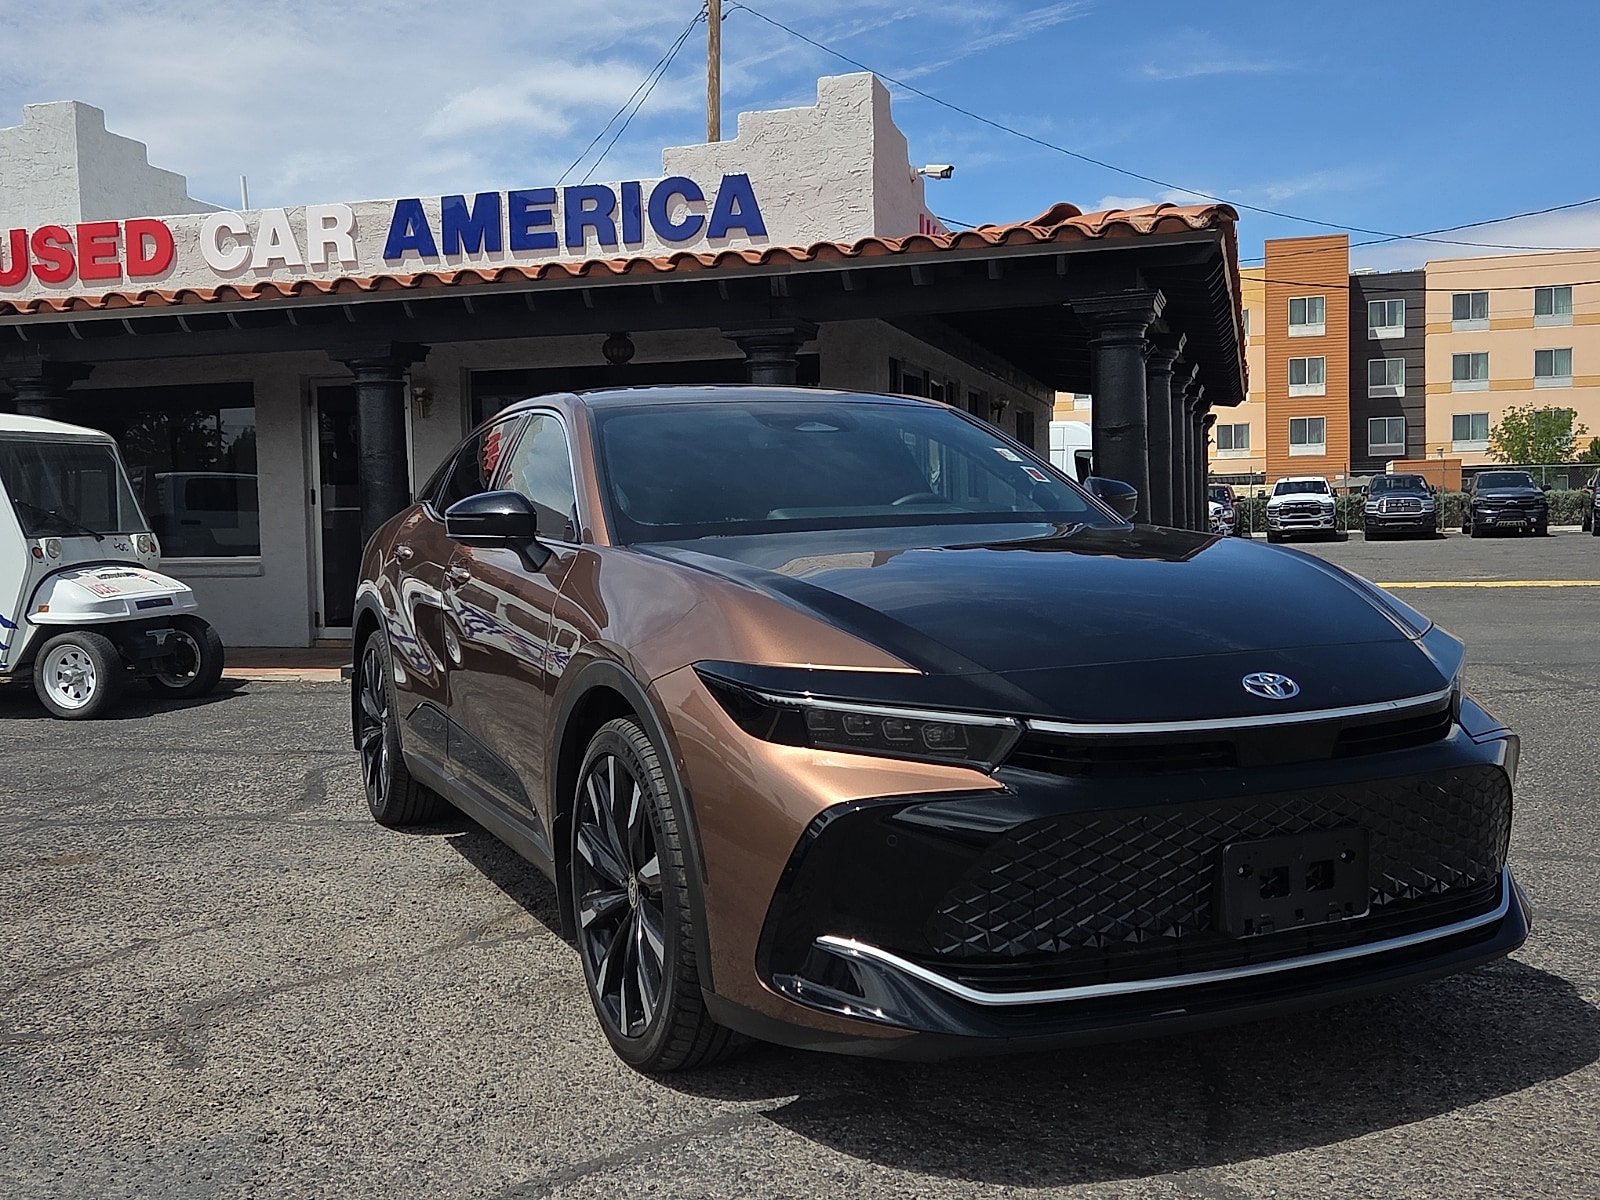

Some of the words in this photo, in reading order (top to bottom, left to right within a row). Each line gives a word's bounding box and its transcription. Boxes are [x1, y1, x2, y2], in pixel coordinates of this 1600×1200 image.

[0, 219, 174, 287] USED
[200, 203, 357, 271] CAR
[382, 172, 768, 260] AMERICA
